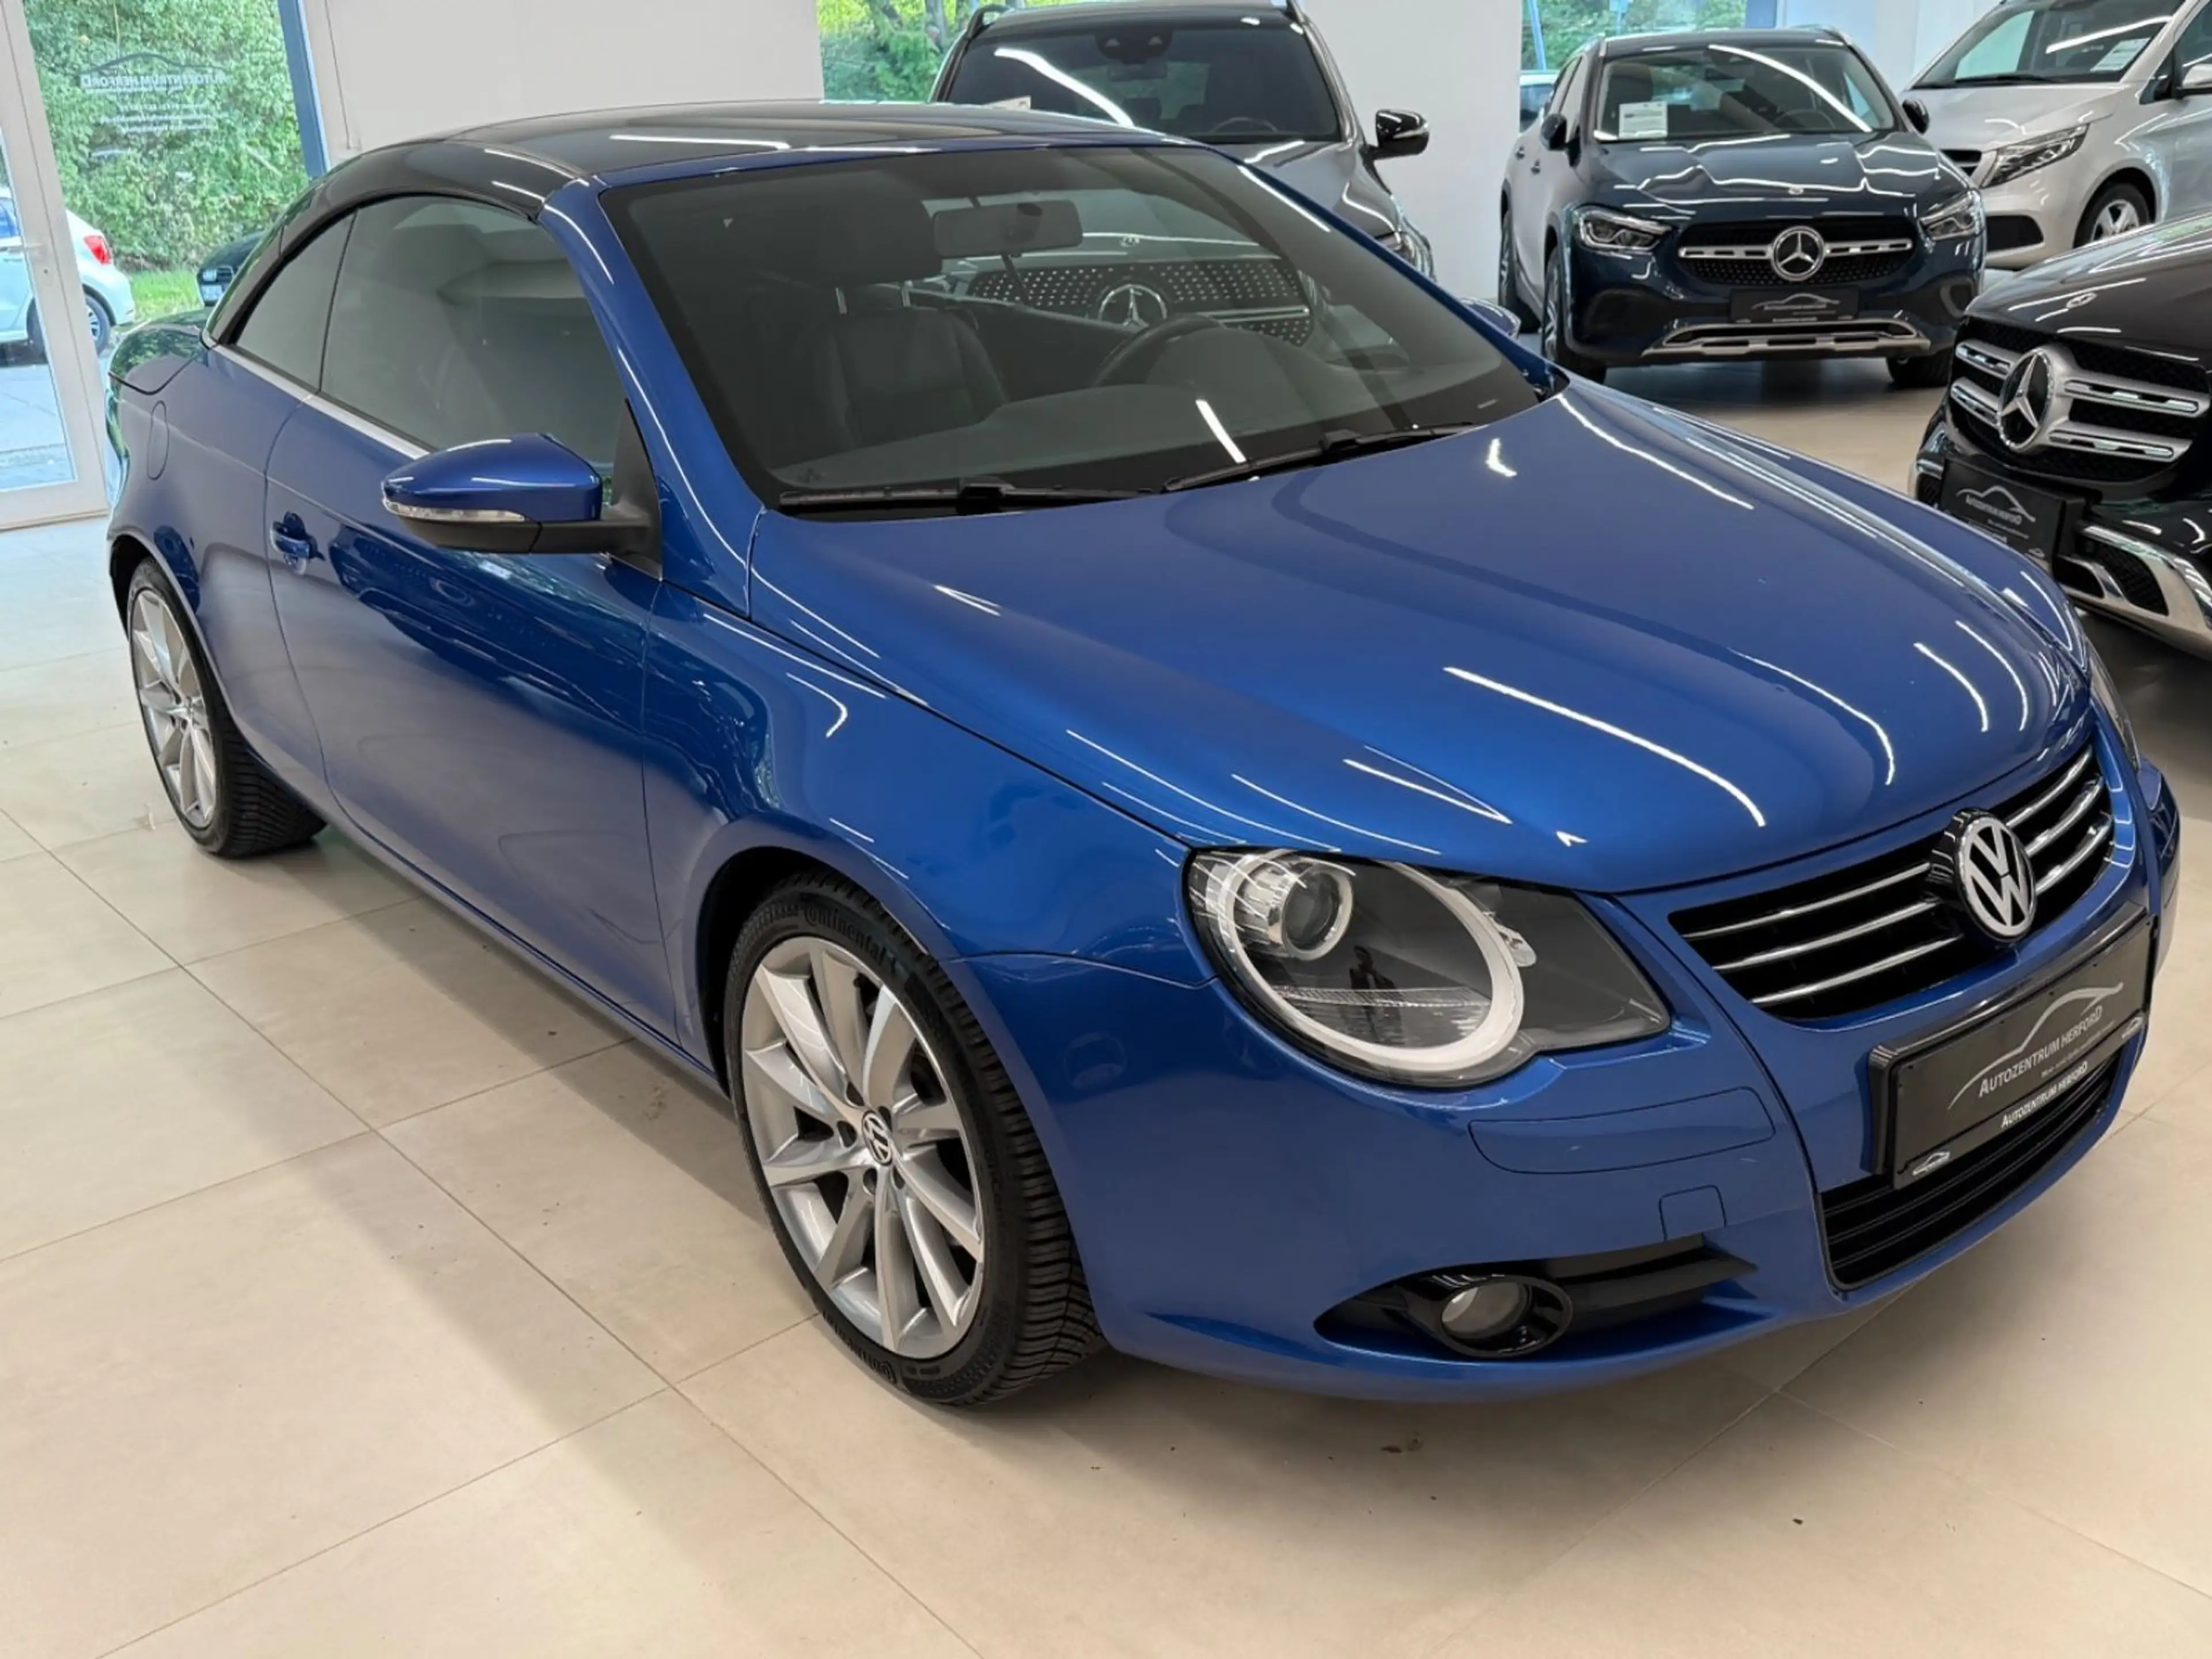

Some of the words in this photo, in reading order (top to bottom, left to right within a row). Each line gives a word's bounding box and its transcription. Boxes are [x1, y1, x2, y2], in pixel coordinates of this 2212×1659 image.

[1960, 817, 2033, 937] VW
[1978, 1037, 2060, 1098] AUTOZENTRUM
[2061, 1005, 2103, 1049] HERFORD
